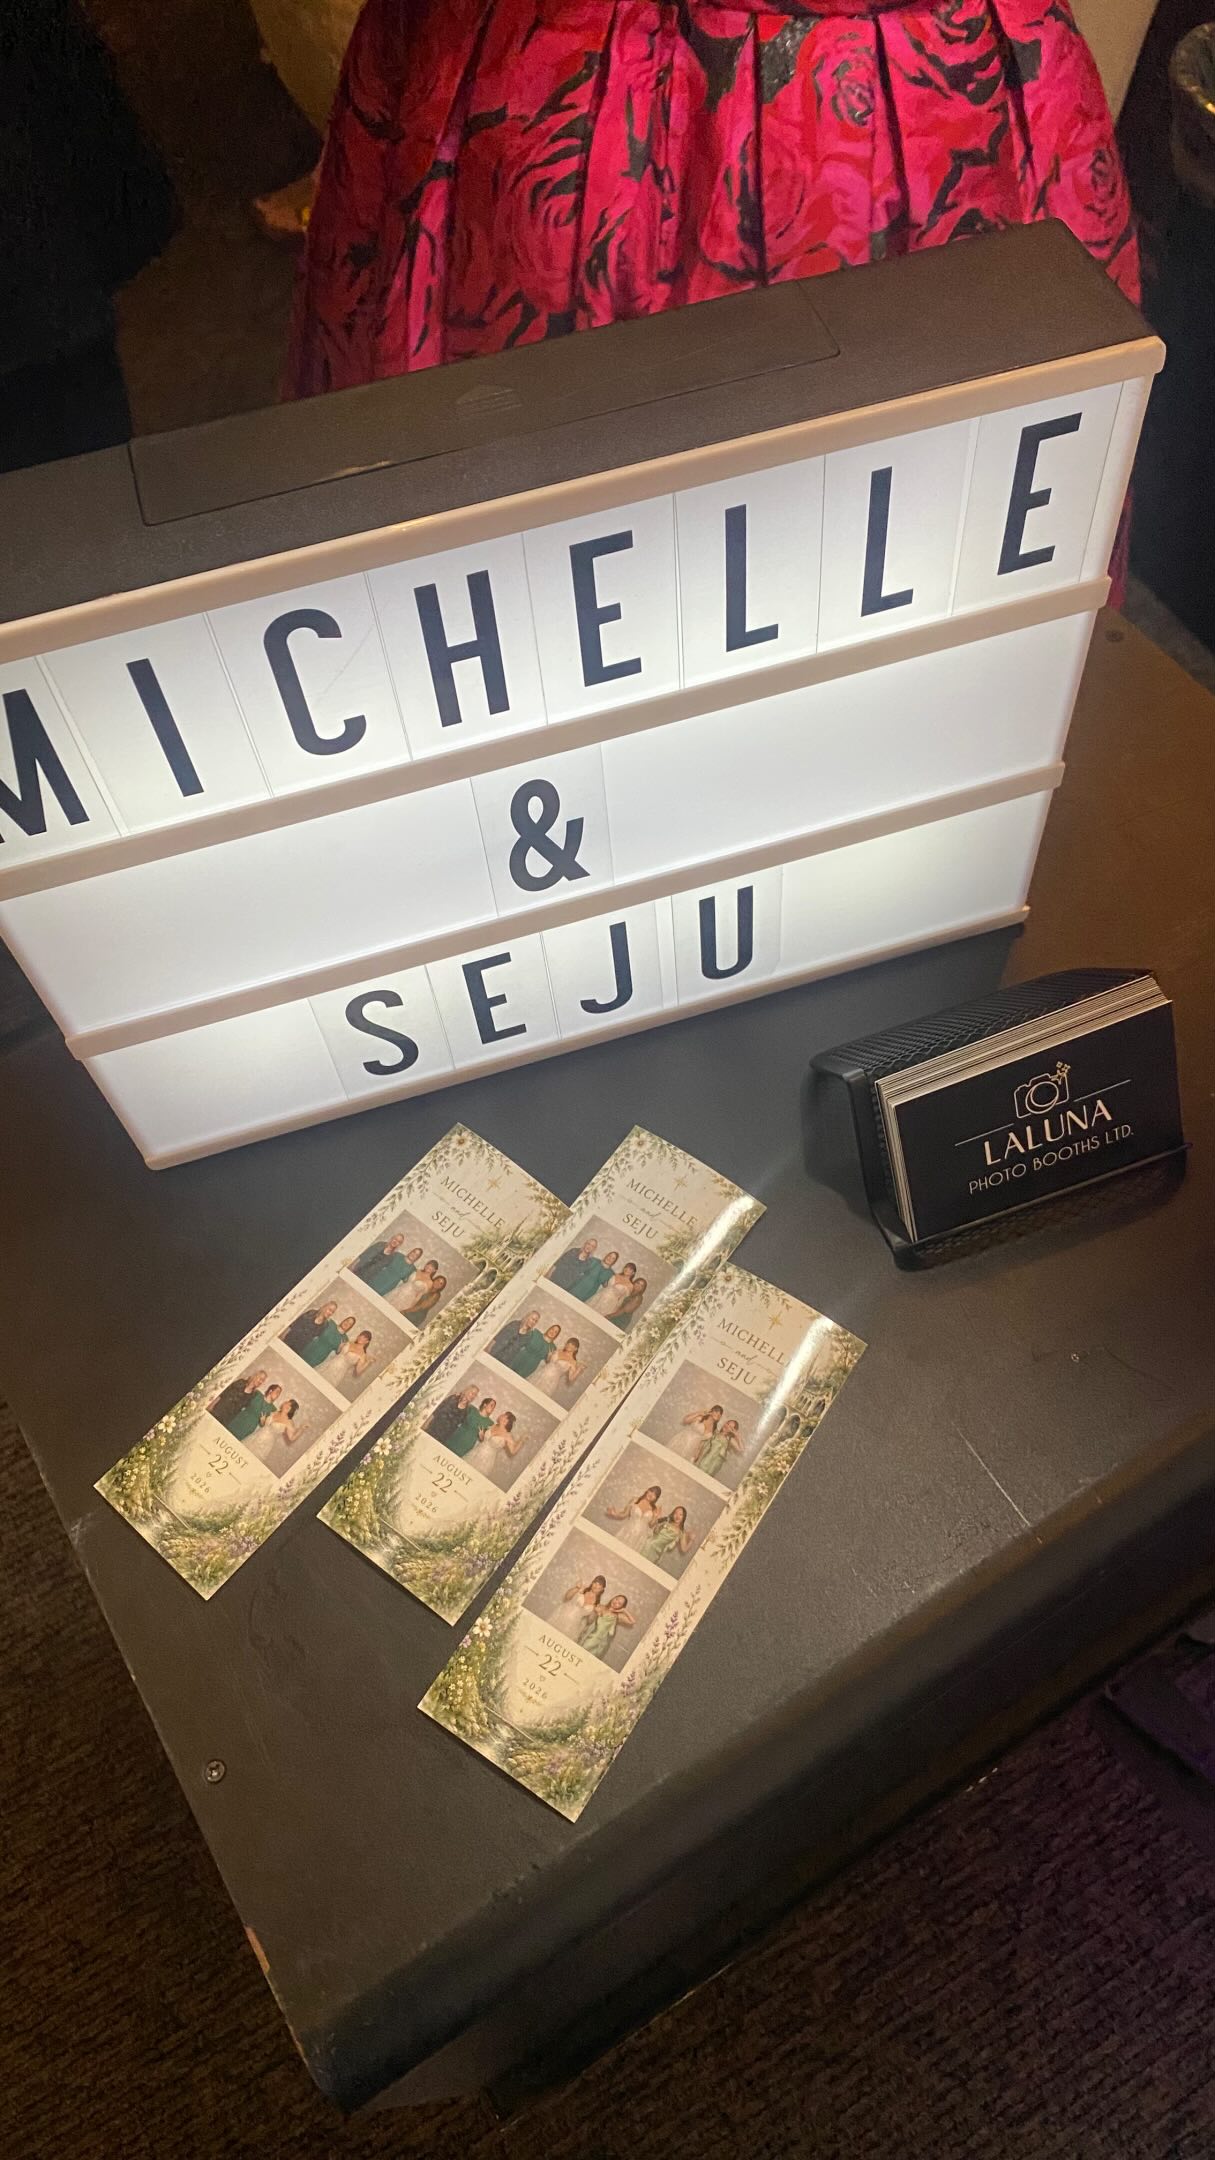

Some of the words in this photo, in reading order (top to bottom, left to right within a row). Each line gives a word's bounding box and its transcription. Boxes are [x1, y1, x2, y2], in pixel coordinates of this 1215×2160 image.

[509, 778, 590, 892] &
[345, 885, 753, 1076] SEJU
[984, 1099, 1112, 1165] LALUNA
[968, 1163, 1027, 1194] PHOTO
[1033, 1135, 1100, 1171] BOOTHS
[1105, 1124, 1134, 1145] LTD.
[440, 1176, 505, 1229] MICHELLE
[626, 1178, 698, 1231] MICHELLE
[431, 1210, 465, 1238] SEJU
[622, 1213, 659, 1239] SEJU
[716, 1357, 757, 1385] SEJU
[208, 1454, 229, 1475] 22
[214, 1437, 249, 1469] AUGUST
[431, 1472, 453, 1494] 22
[433, 1455, 473, 1486] AUGUST
[538, 1634, 584, 1667] AUGUST
[538, 1654, 562, 1677] 22
